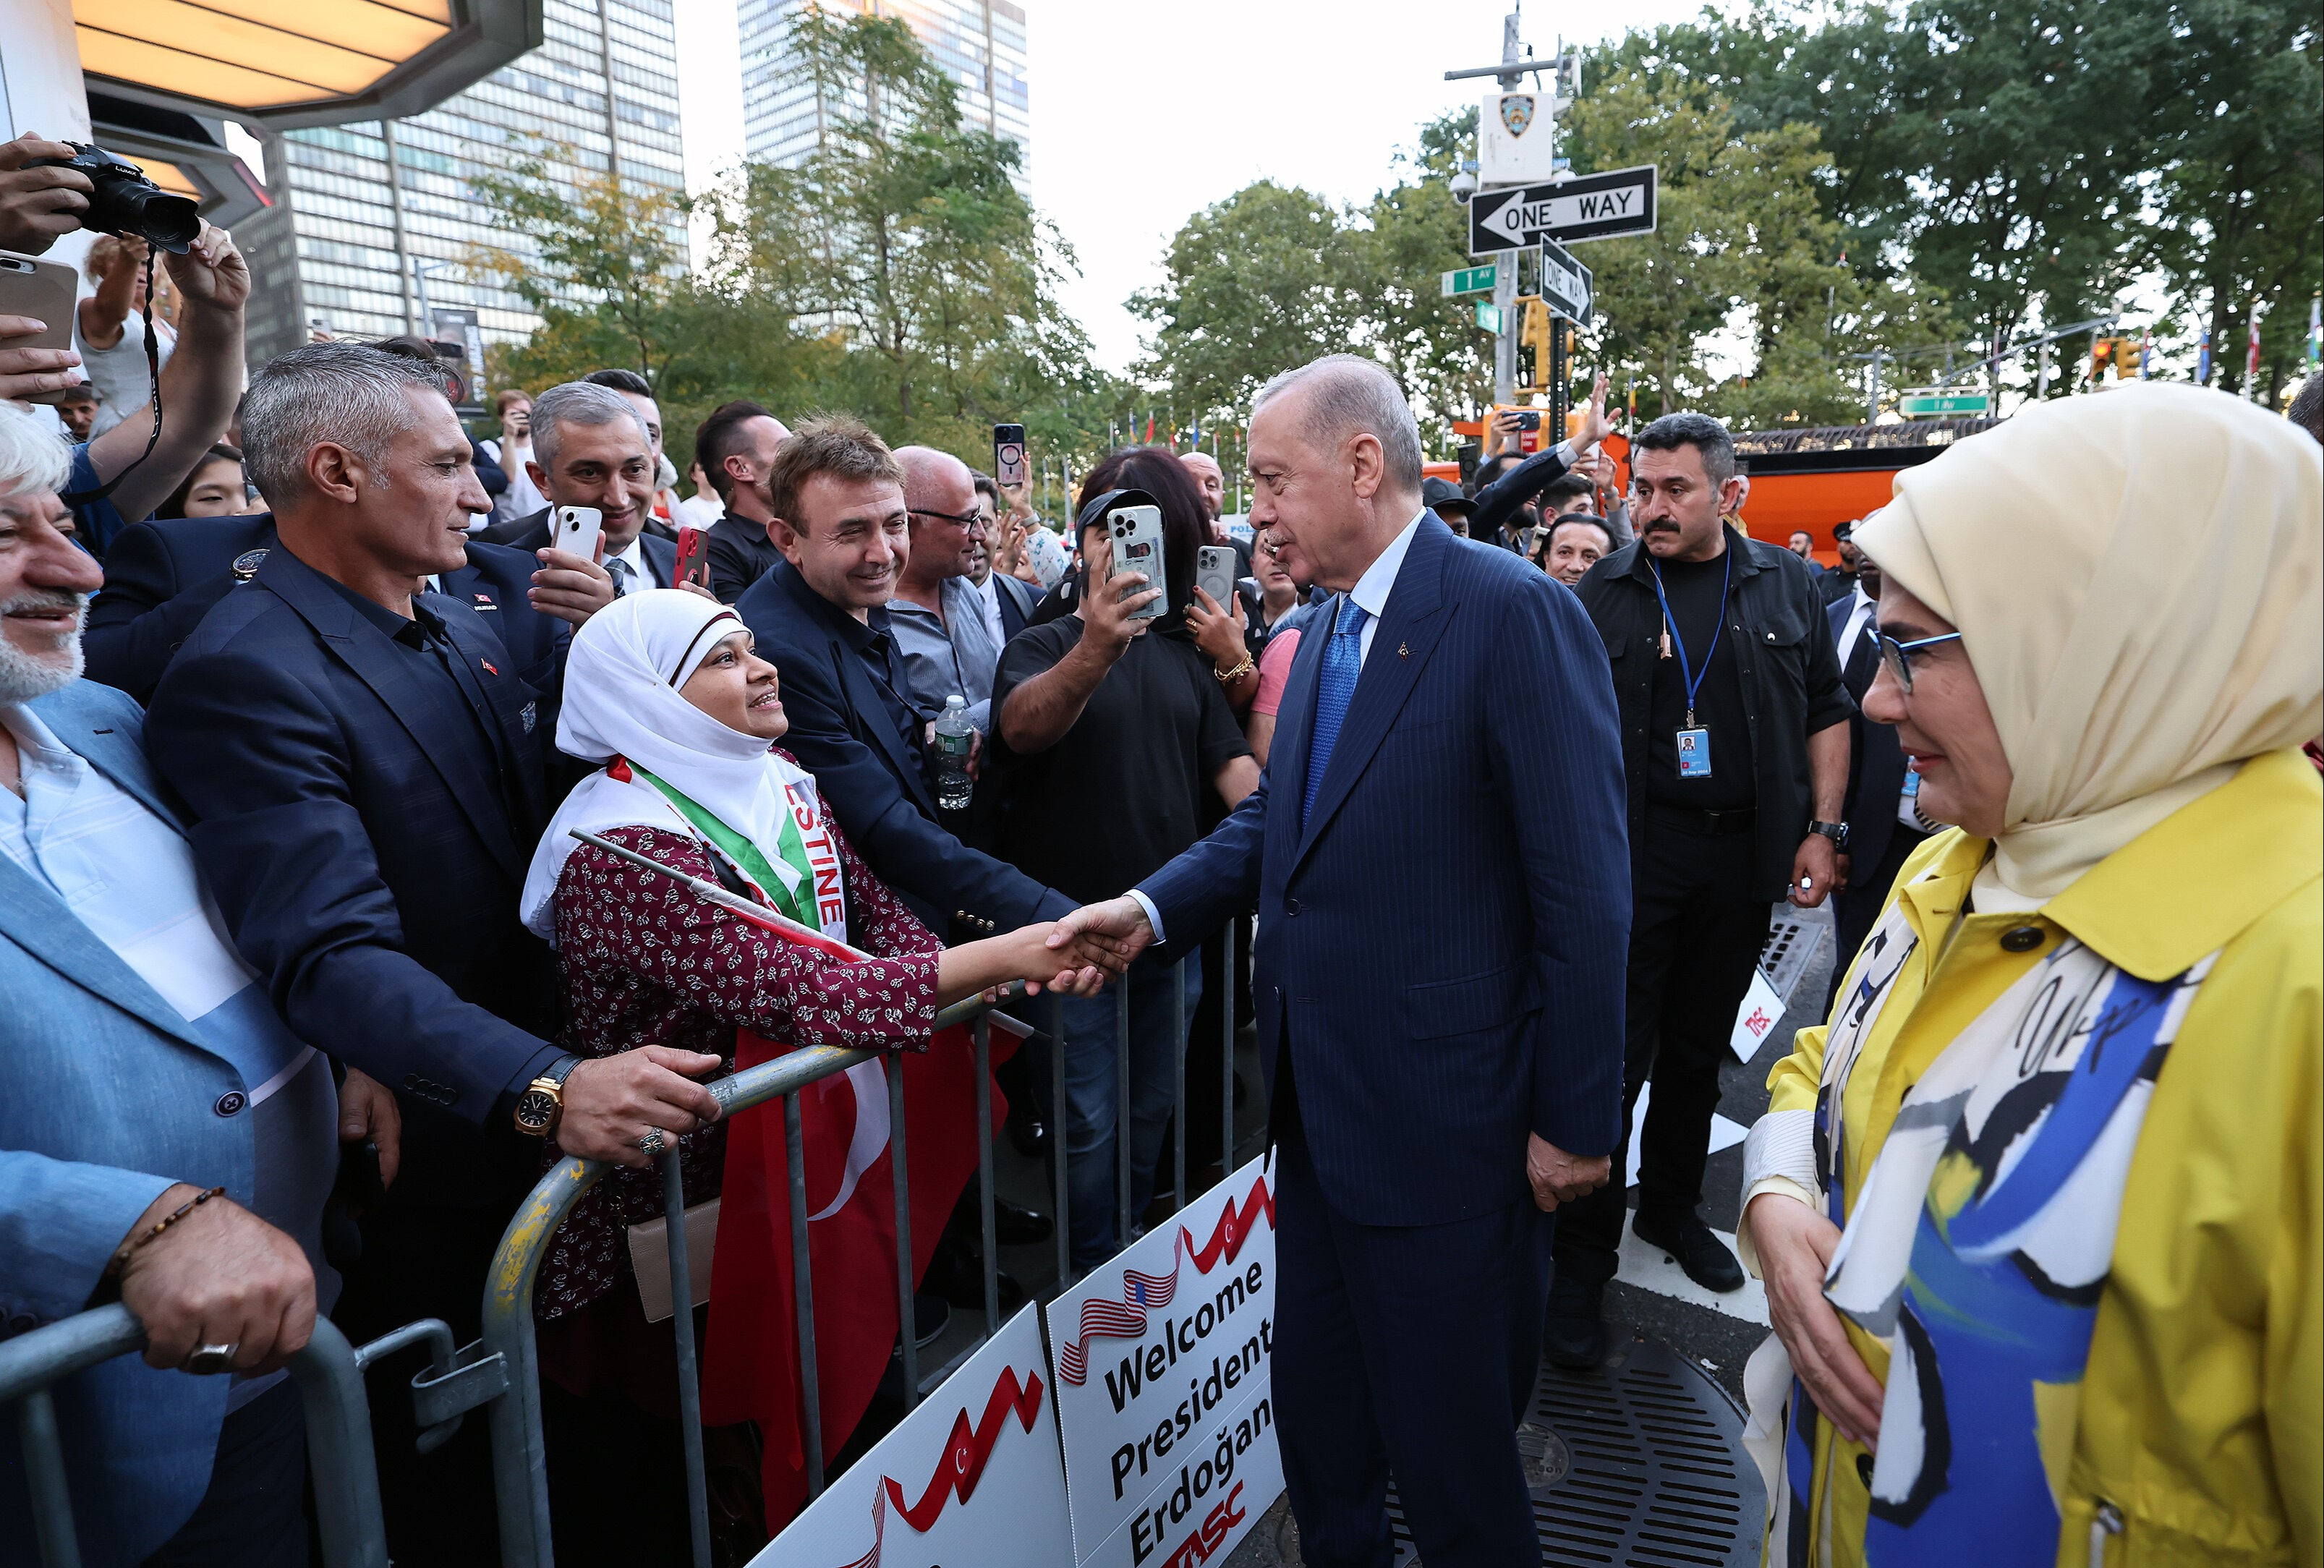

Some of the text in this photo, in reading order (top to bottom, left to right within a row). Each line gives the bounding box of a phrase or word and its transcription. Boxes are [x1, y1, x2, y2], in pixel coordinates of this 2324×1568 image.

[115, 165, 137, 176] LUMIX
[1505, 190, 1633, 230] ONE WAY
[1466, 269, 1491, 289] 1 AV
[1548, 261, 1562, 291] ONE
[1569, 277, 1583, 304] WAY
[1104, 1261, 1262, 1415] Welcome
[1110, 1318, 1272, 1501] President
[1130, 1397, 1271, 1568] Erdoğan
